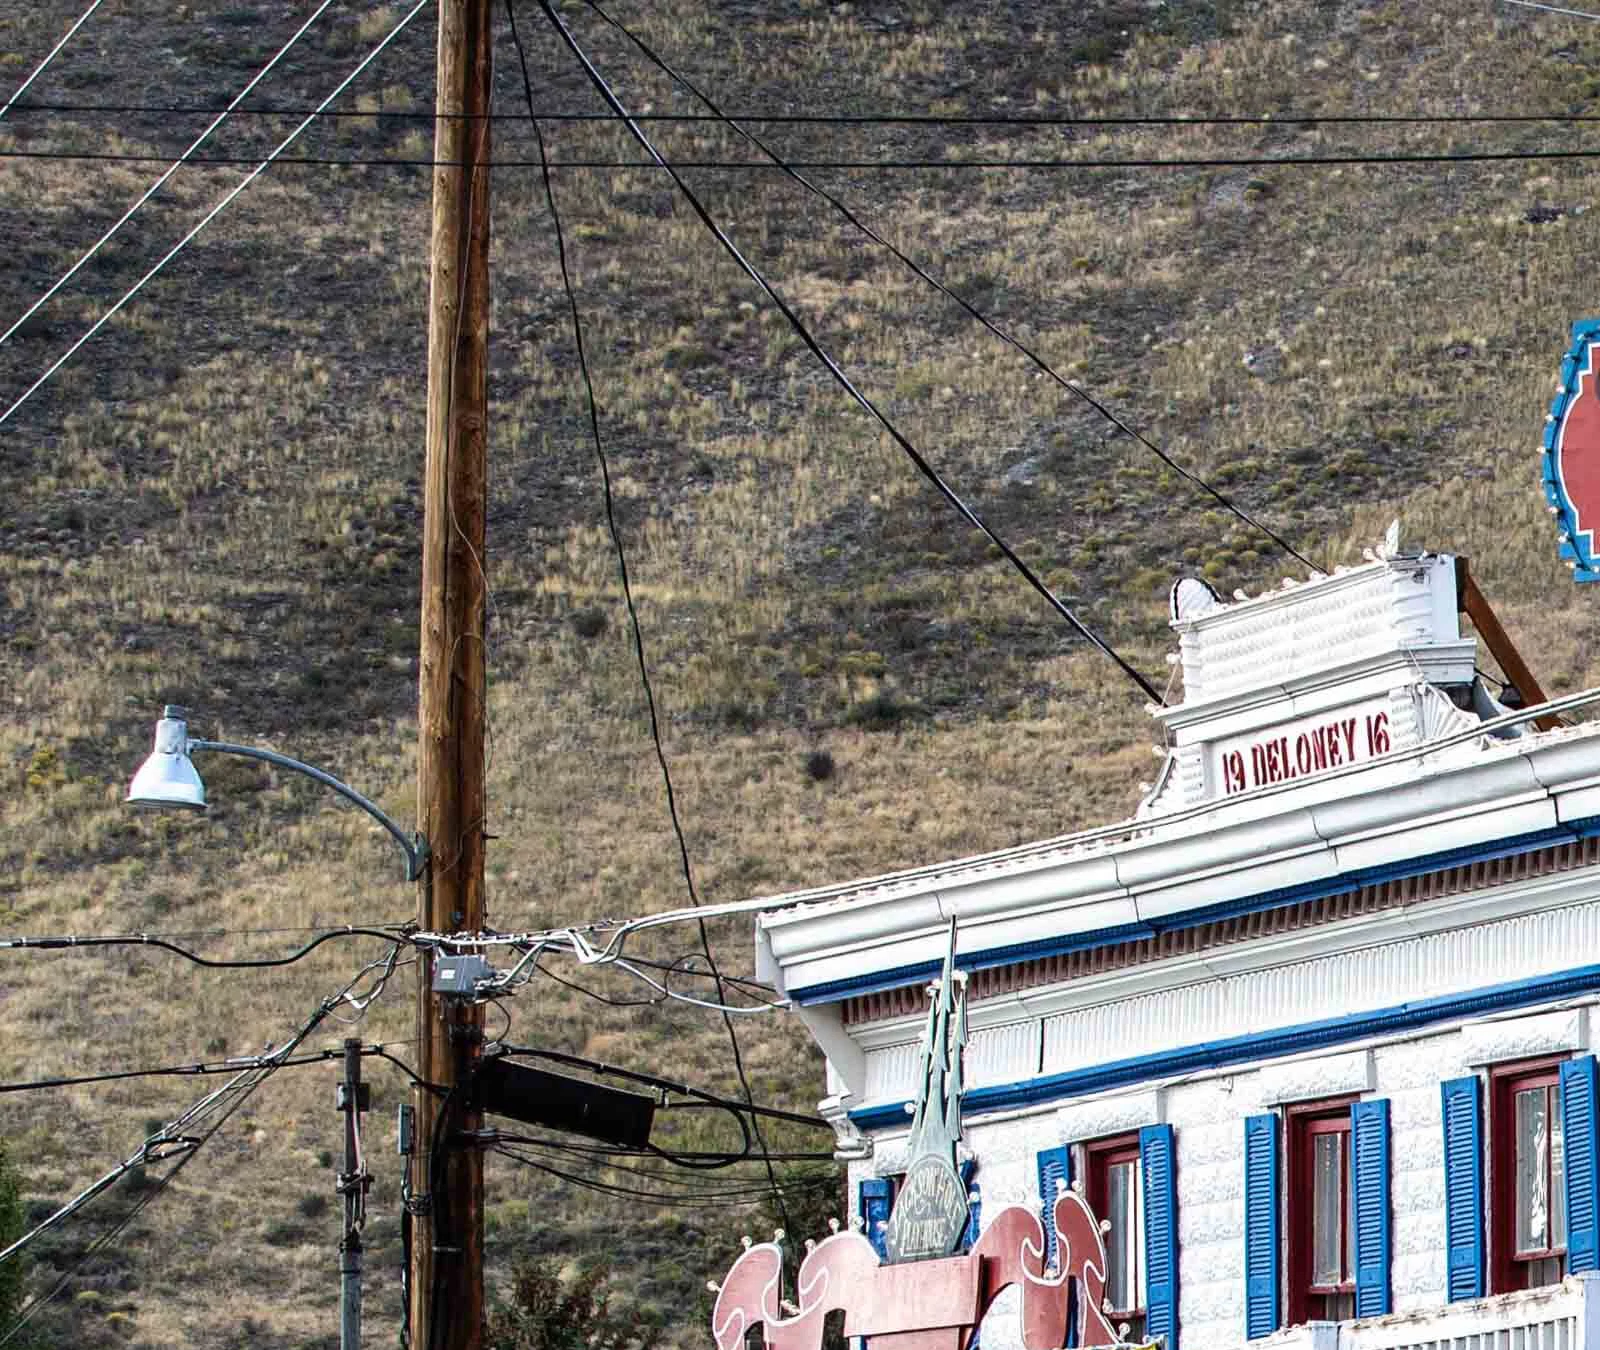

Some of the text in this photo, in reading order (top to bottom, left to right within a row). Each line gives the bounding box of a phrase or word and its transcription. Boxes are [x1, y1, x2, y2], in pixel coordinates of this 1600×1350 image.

[1221, 711, 1391, 795] 19 DELONEY 16
